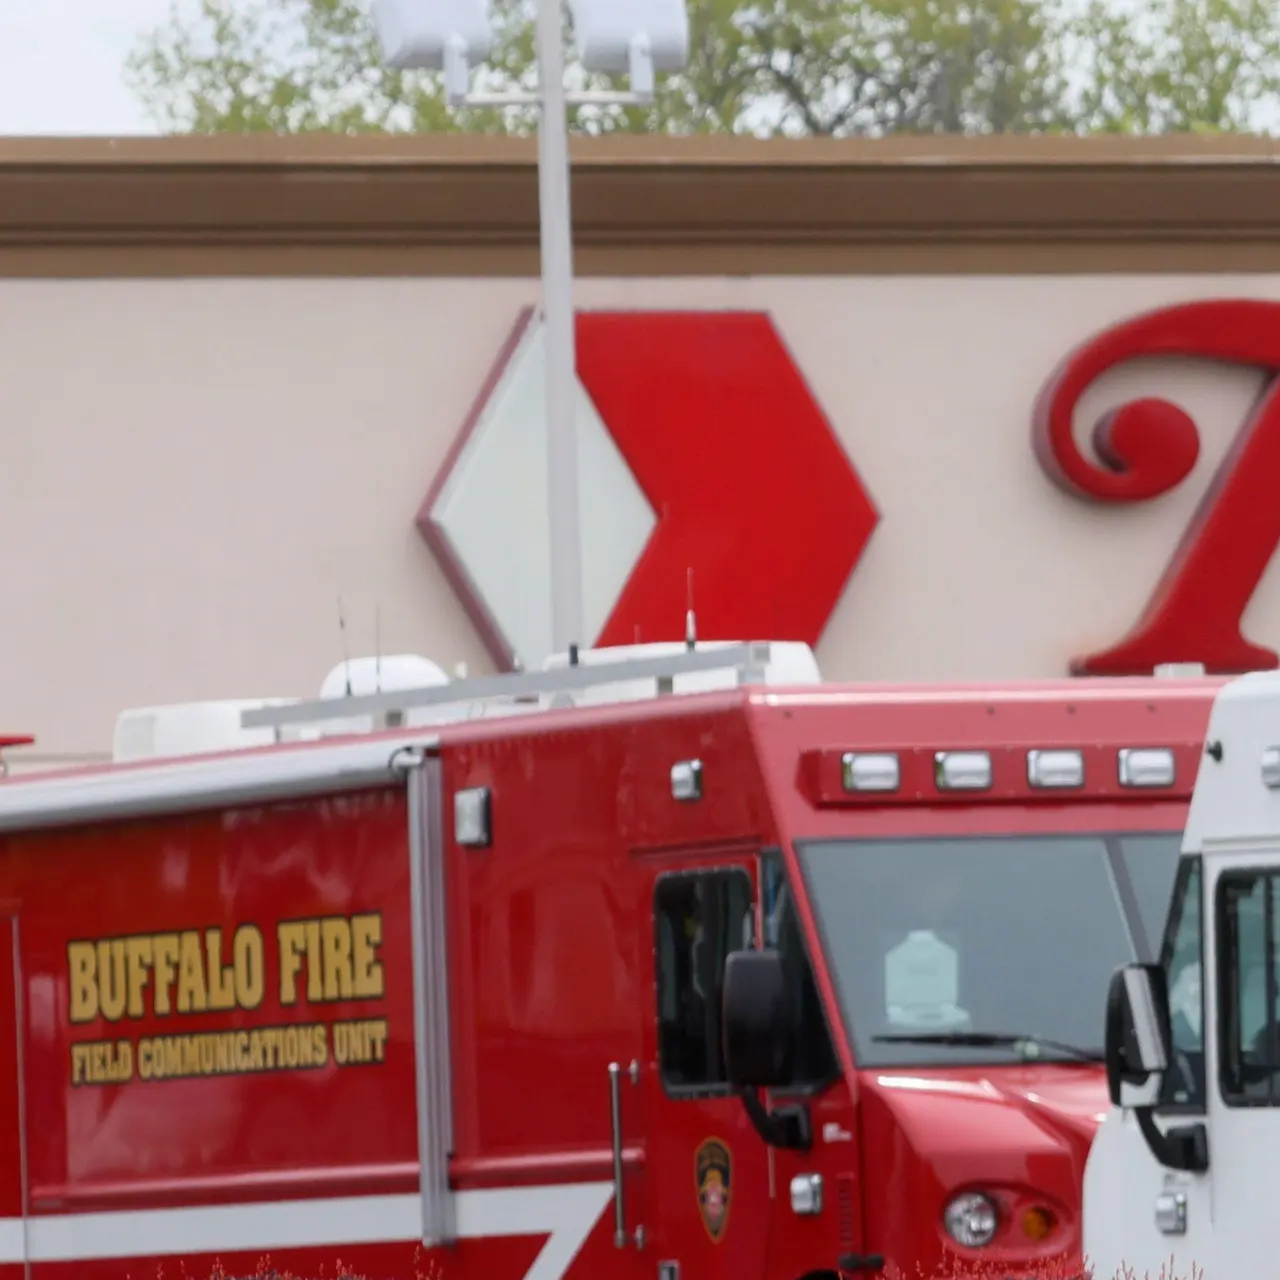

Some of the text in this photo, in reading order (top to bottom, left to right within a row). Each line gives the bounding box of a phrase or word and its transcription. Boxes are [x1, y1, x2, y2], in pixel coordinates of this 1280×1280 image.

[68, 911, 386, 1022] BUFFALO FIRE
[70, 1019, 389, 1087] FIELD COMMUNICATIONS UNIT
